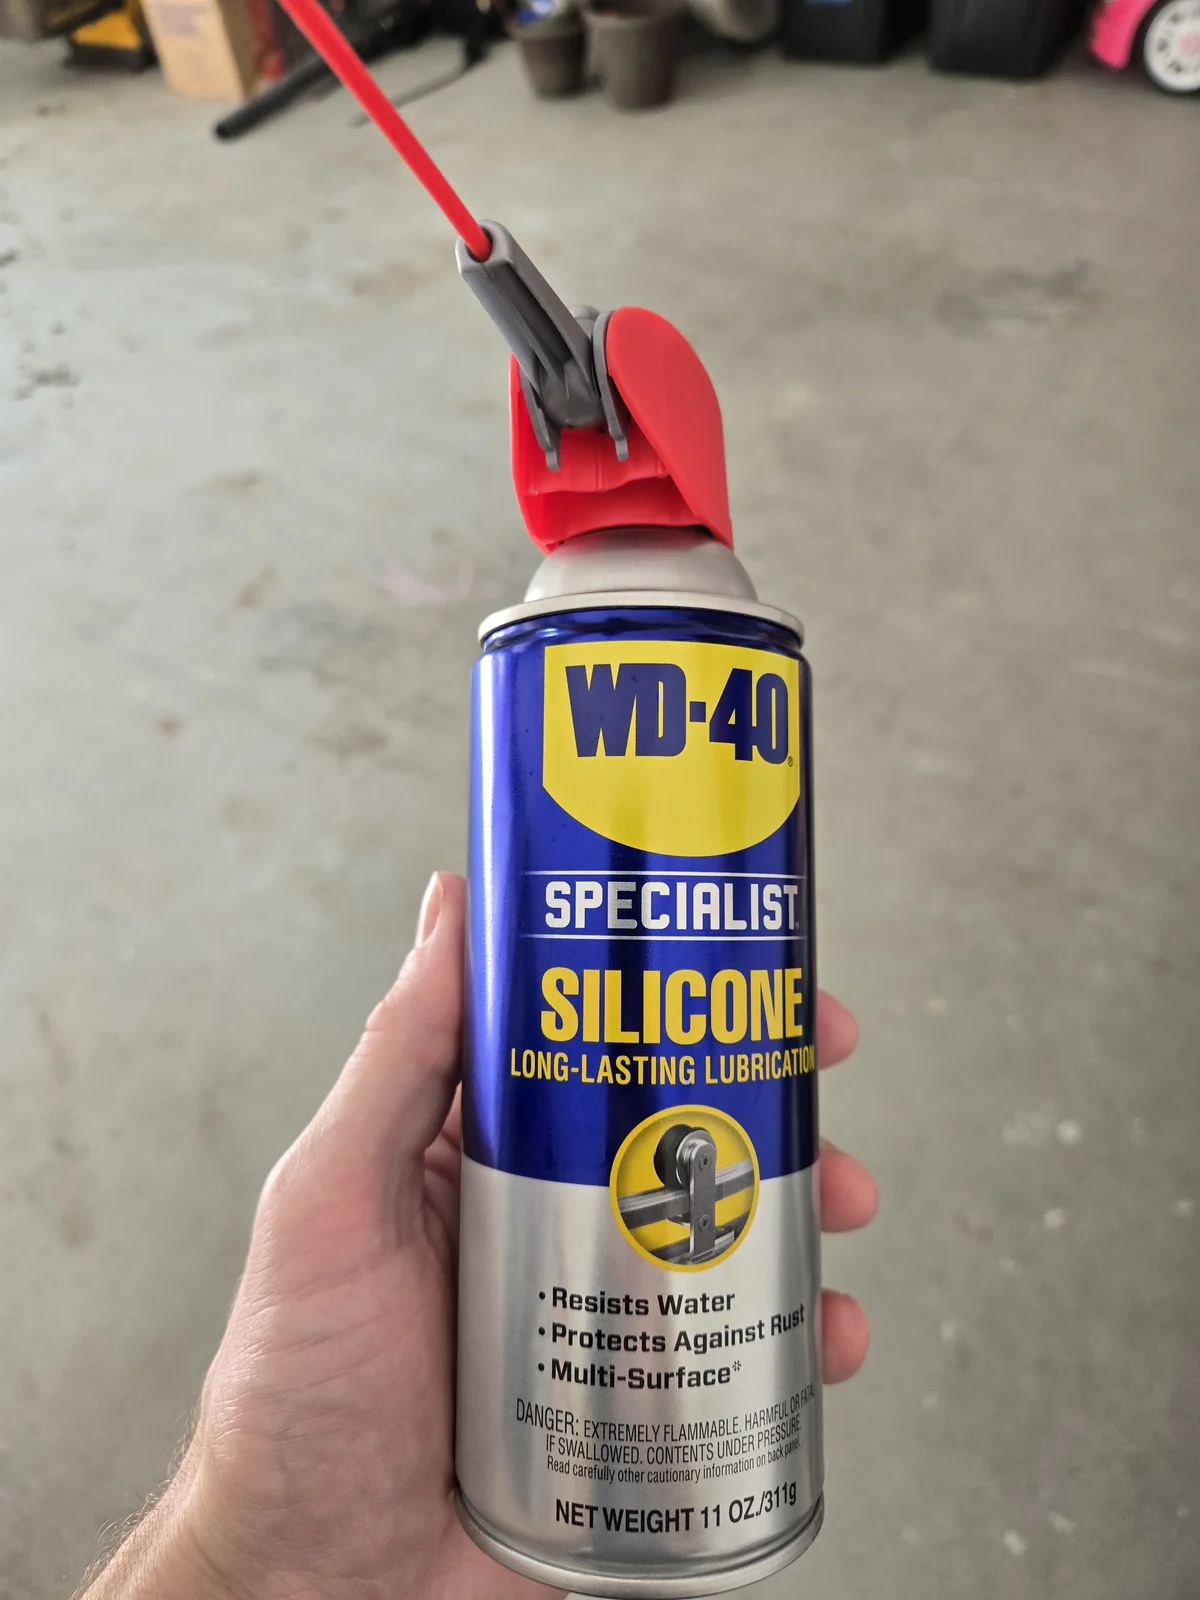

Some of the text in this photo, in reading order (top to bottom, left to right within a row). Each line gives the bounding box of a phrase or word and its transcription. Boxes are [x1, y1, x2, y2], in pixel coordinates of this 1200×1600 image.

[545, 881, 798, 930] SPECIALIST
[541, 967, 803, 1045] SILICONE
[510, 1044, 815, 1085] LONG-LASTING LUBRICATION
[552, 1286, 736, 1316] Resists Water
[552, 1303, 806, 1355] Protects Against Rust
[516, 1398, 580, 1436] DANGER:
[583, 1420, 661, 1443] EXTREMELY
[663, 1416, 742, 1443] FLAMMABLE.
[744, 1401, 789, 1432] HARMFUL
[790, 1393, 801, 1415] OR
[546, 1413, 802, 1465] IF SWALLOWED. CONTENTS UNDER PRESSURE.
[547, 1455, 570, 1475] Read
[572, 1464, 616, 1485] carefully
[617, 1468, 645, 1483] other
[647, 1467, 701, 1484] cautionary
[703, 1456, 755, 1480] information
[756, 1453, 767, 1468] on
[767, 1443, 784, 1464] back
[555, 1480, 797, 1534] NET WEIGHT 11 OZ./311g
